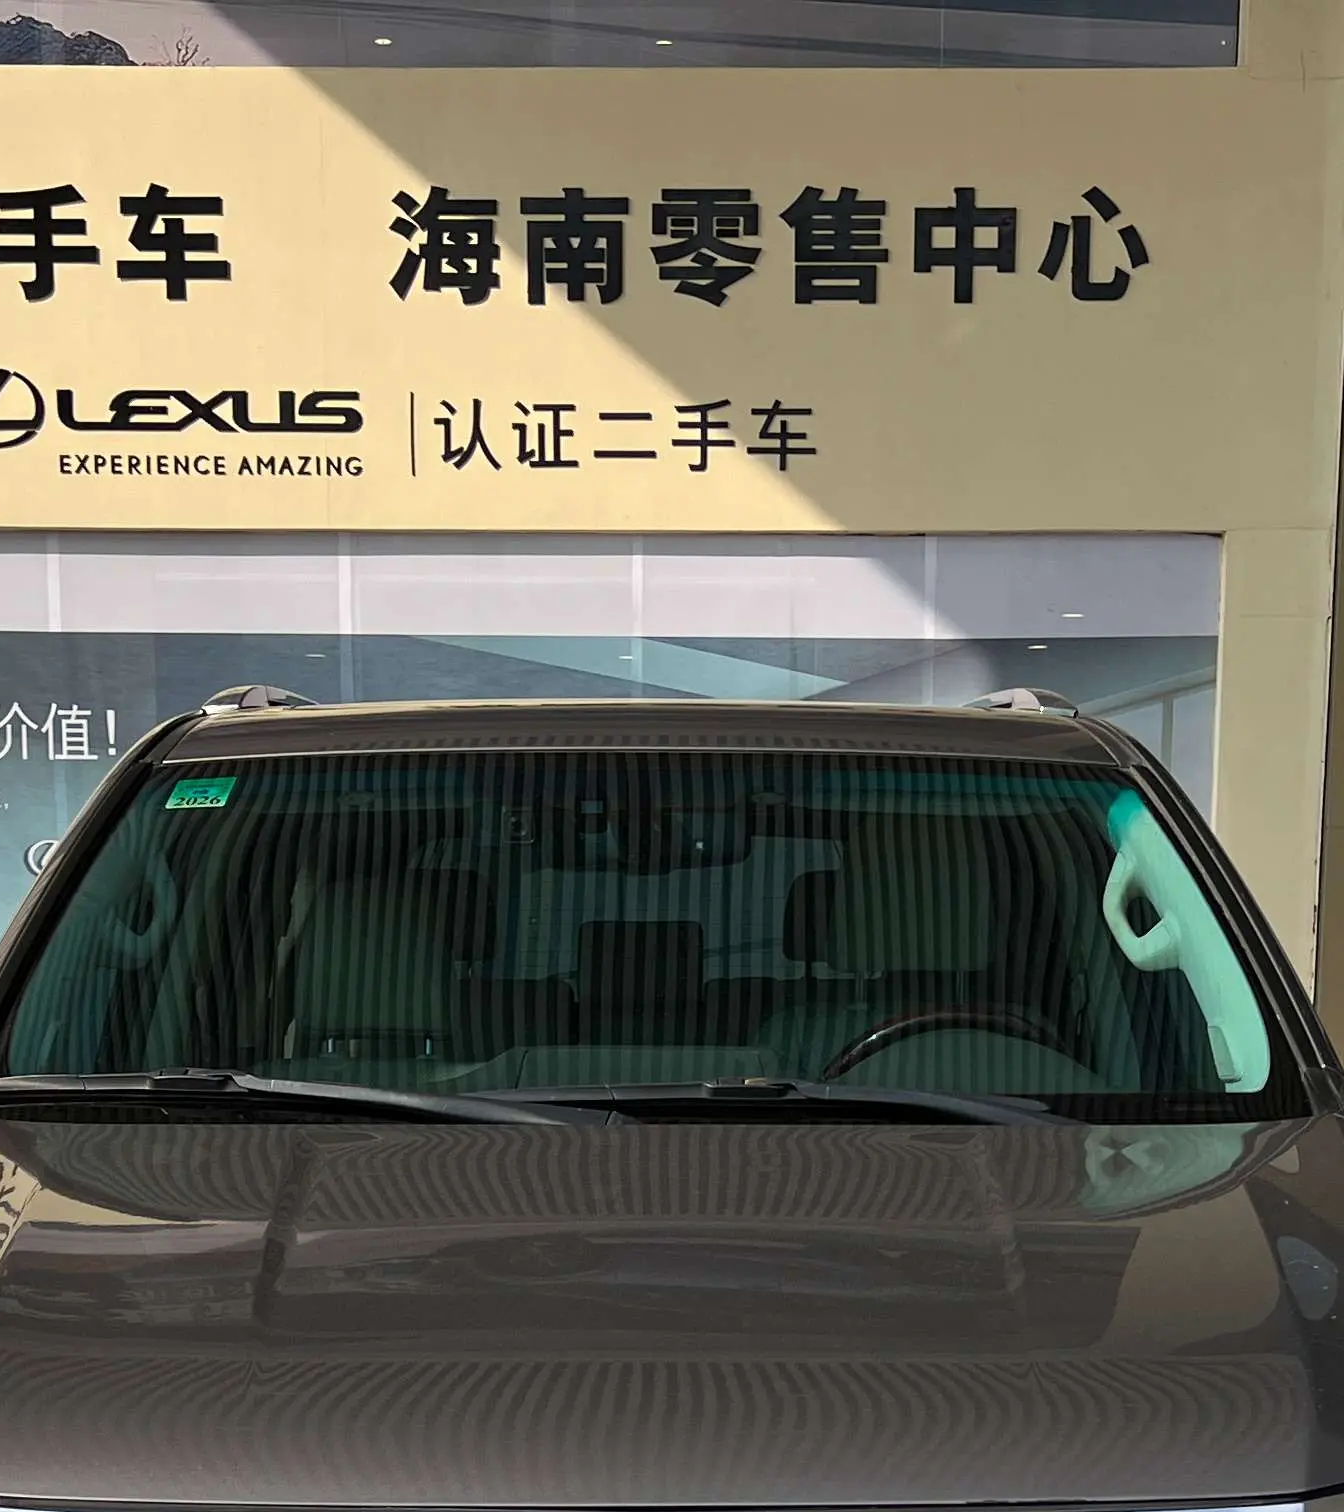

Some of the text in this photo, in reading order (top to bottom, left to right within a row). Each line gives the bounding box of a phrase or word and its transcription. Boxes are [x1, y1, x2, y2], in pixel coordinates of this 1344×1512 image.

[388, 186, 1150, 307] 海南零售中心
[56, 389, 364, 434] LEXUS
[433, 398, 819, 473] 认证二手车
[59, 454, 364, 478] EXPERIENCE AMAZING
[173, 795, 222, 806] 2026
